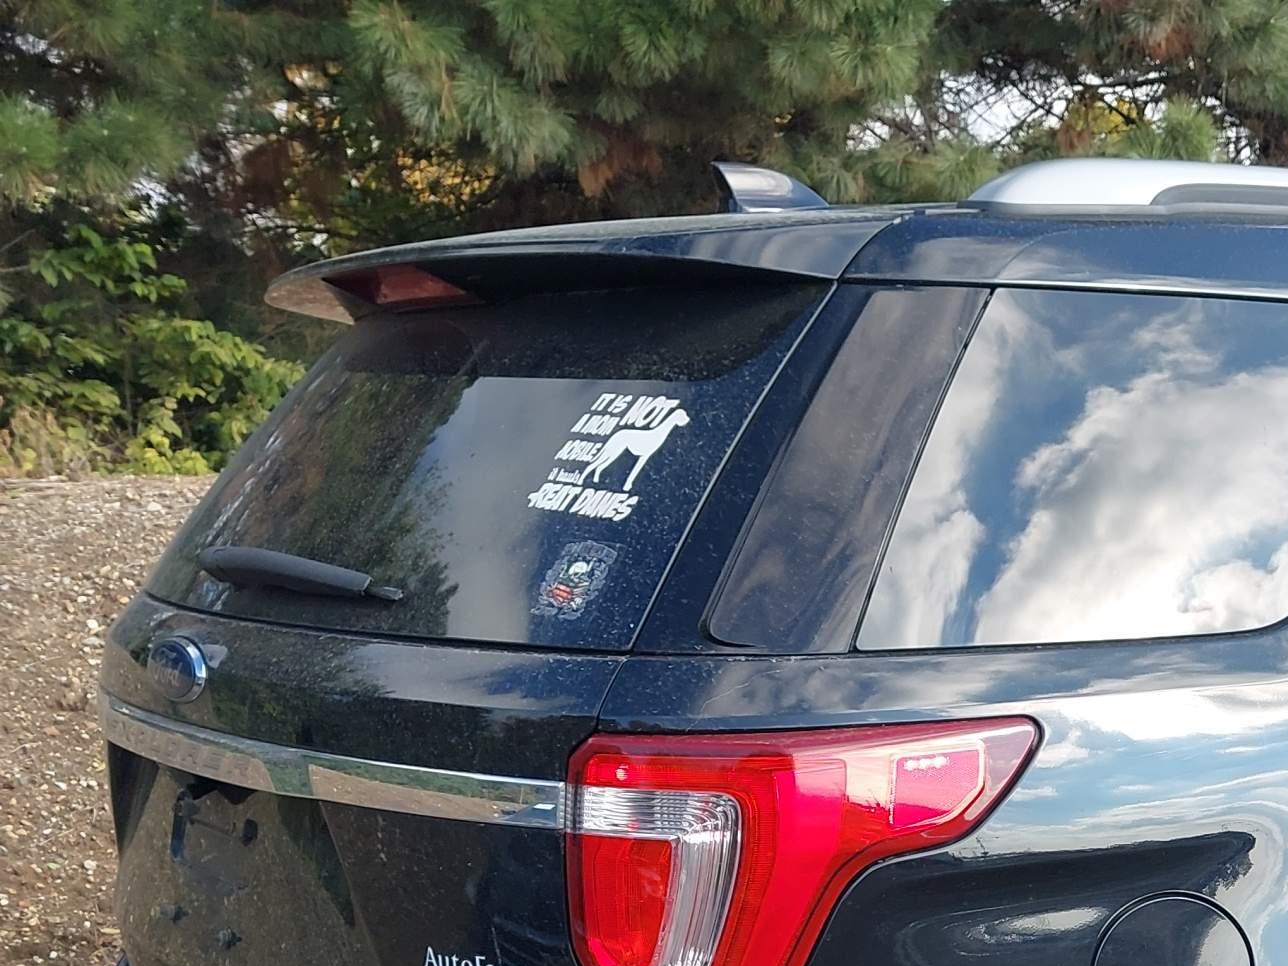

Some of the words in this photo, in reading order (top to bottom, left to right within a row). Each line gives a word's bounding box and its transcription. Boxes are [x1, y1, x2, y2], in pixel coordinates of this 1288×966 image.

[590, 393, 617, 412] IT
[607, 395, 633, 414] IS
[619, 395, 681, 428] NOT
[568, 488, 639, 522] DANES
